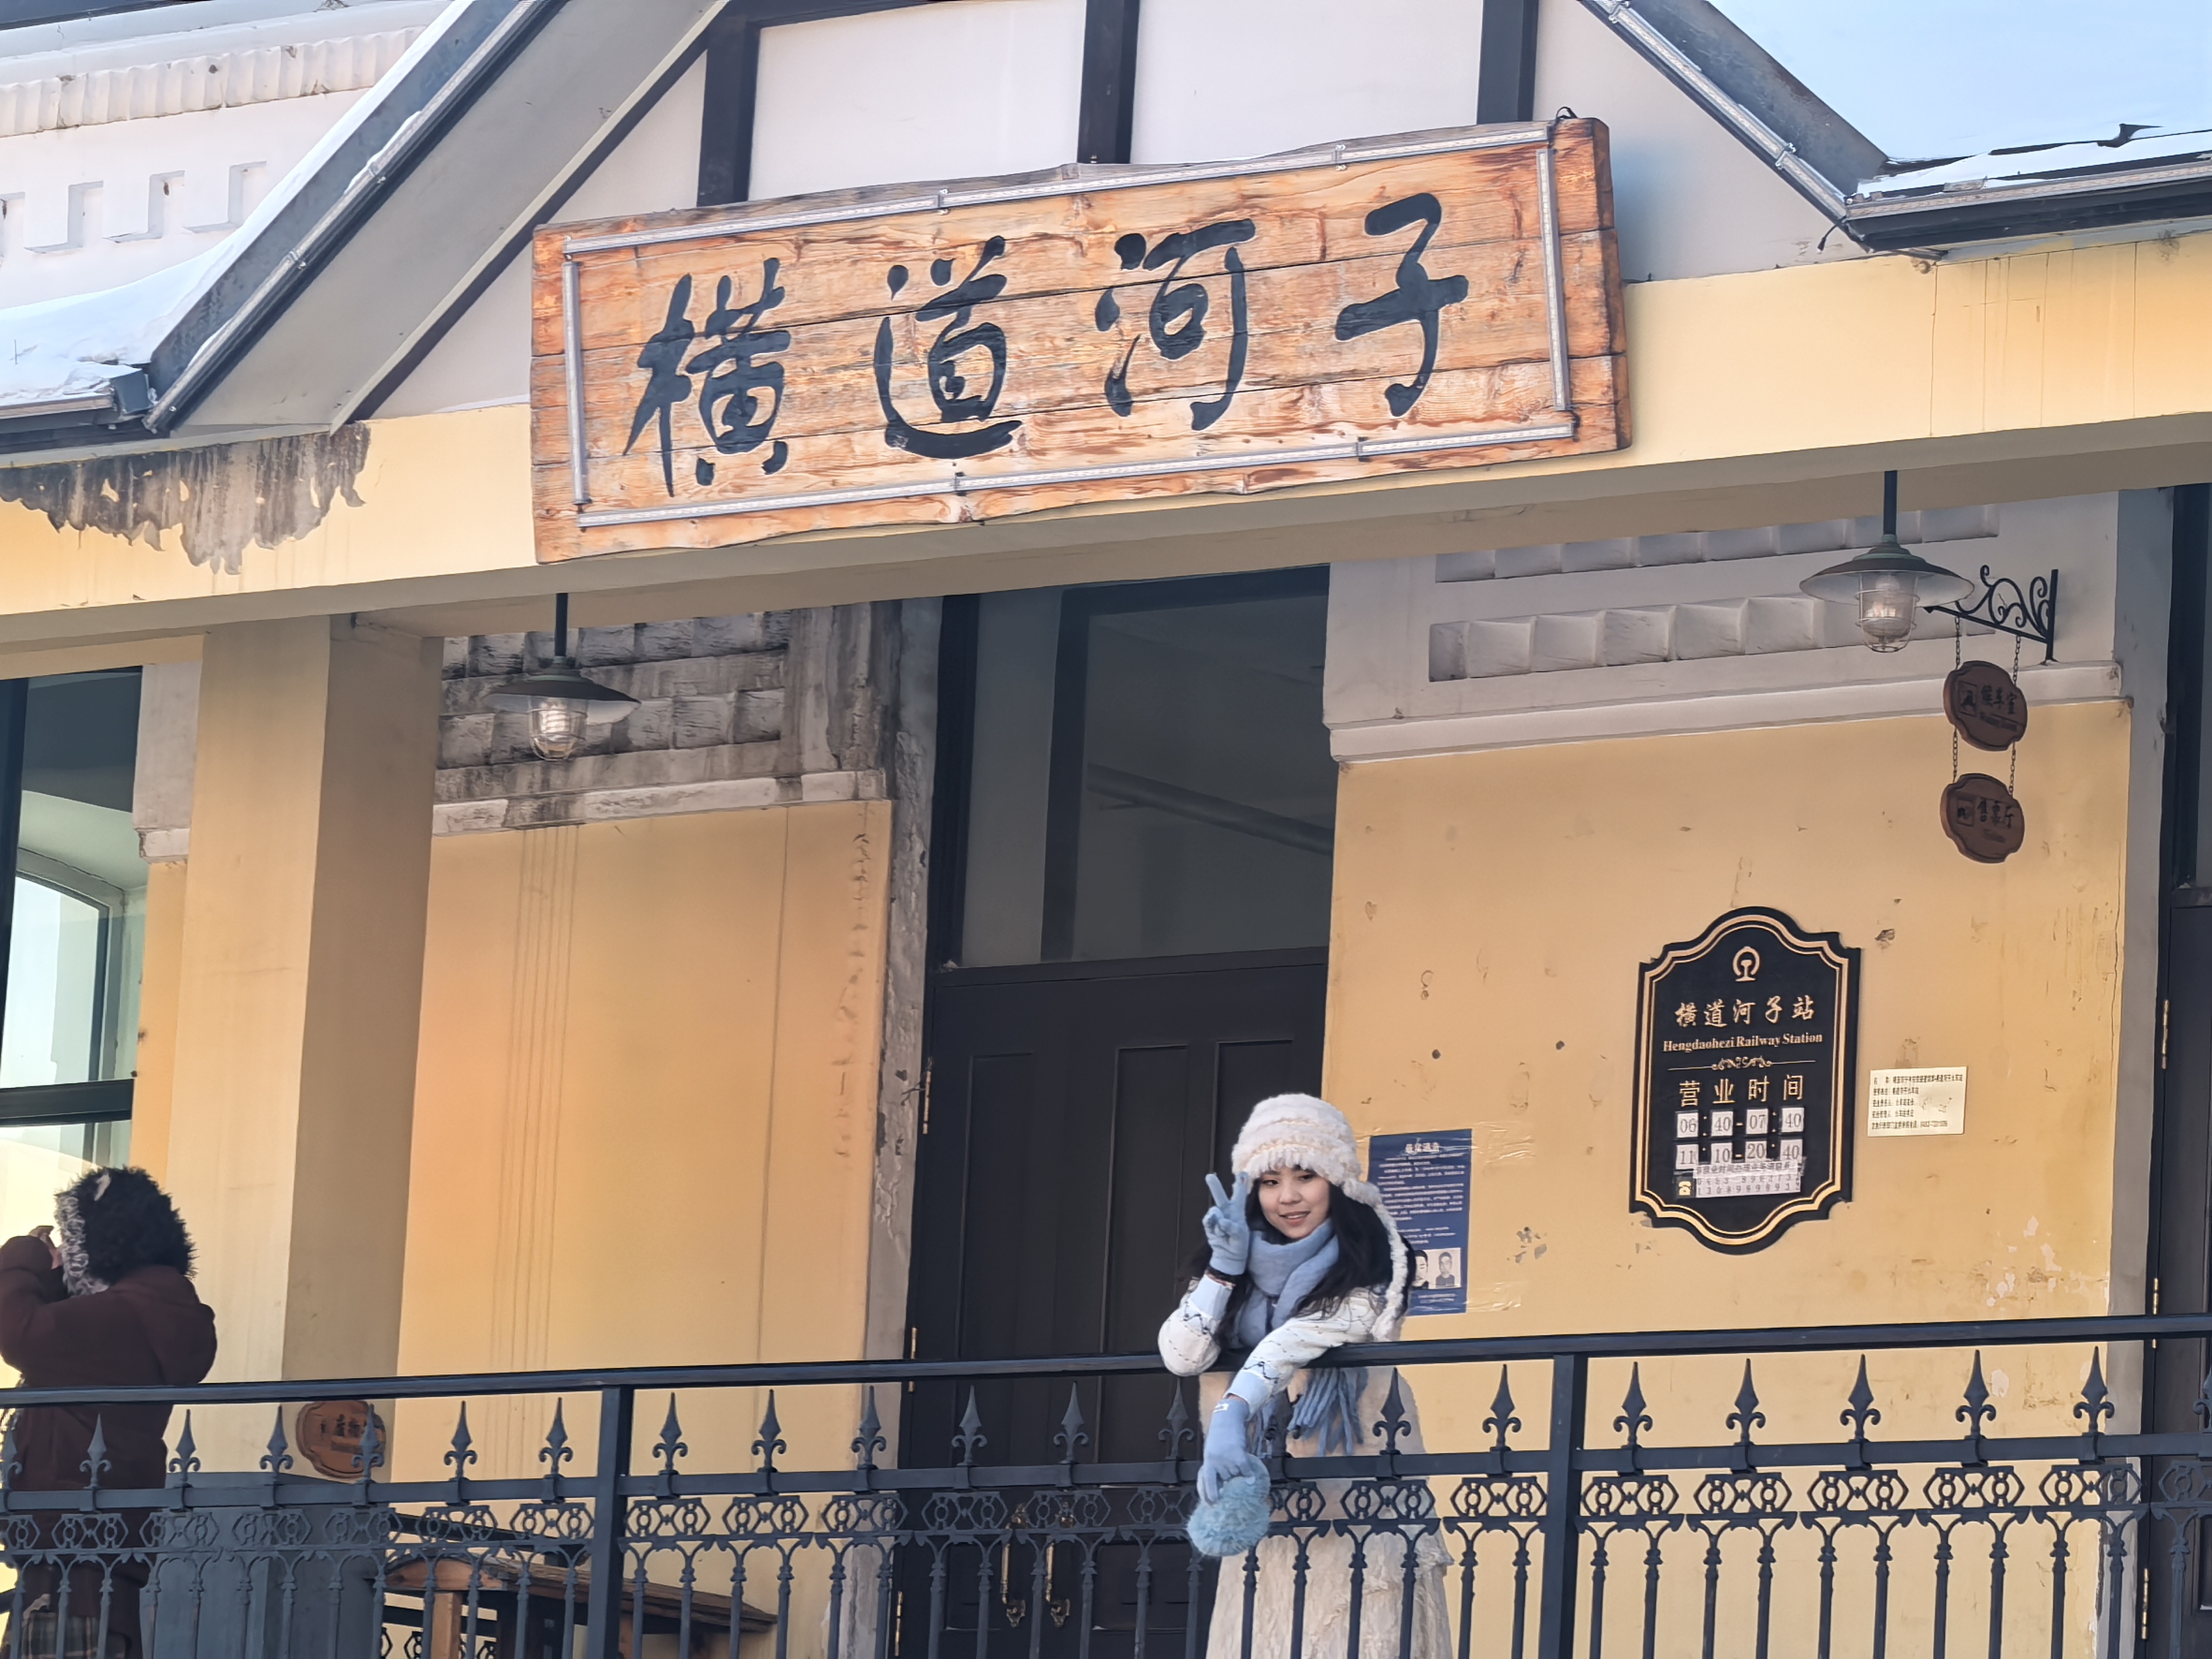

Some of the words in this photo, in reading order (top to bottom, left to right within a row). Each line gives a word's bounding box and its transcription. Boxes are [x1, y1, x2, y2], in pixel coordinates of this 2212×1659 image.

[621, 192, 1469, 497] 横道河子
[1674, 995, 1815, 1027] 横道河子站
[1663, 1036, 1735, 1053] Hengdaohezi
[1736, 1035, 1781, 1047] Railway
[1782, 1032, 1823, 1045] Station
[1679, 1074, 1803, 1107] 营业时间
